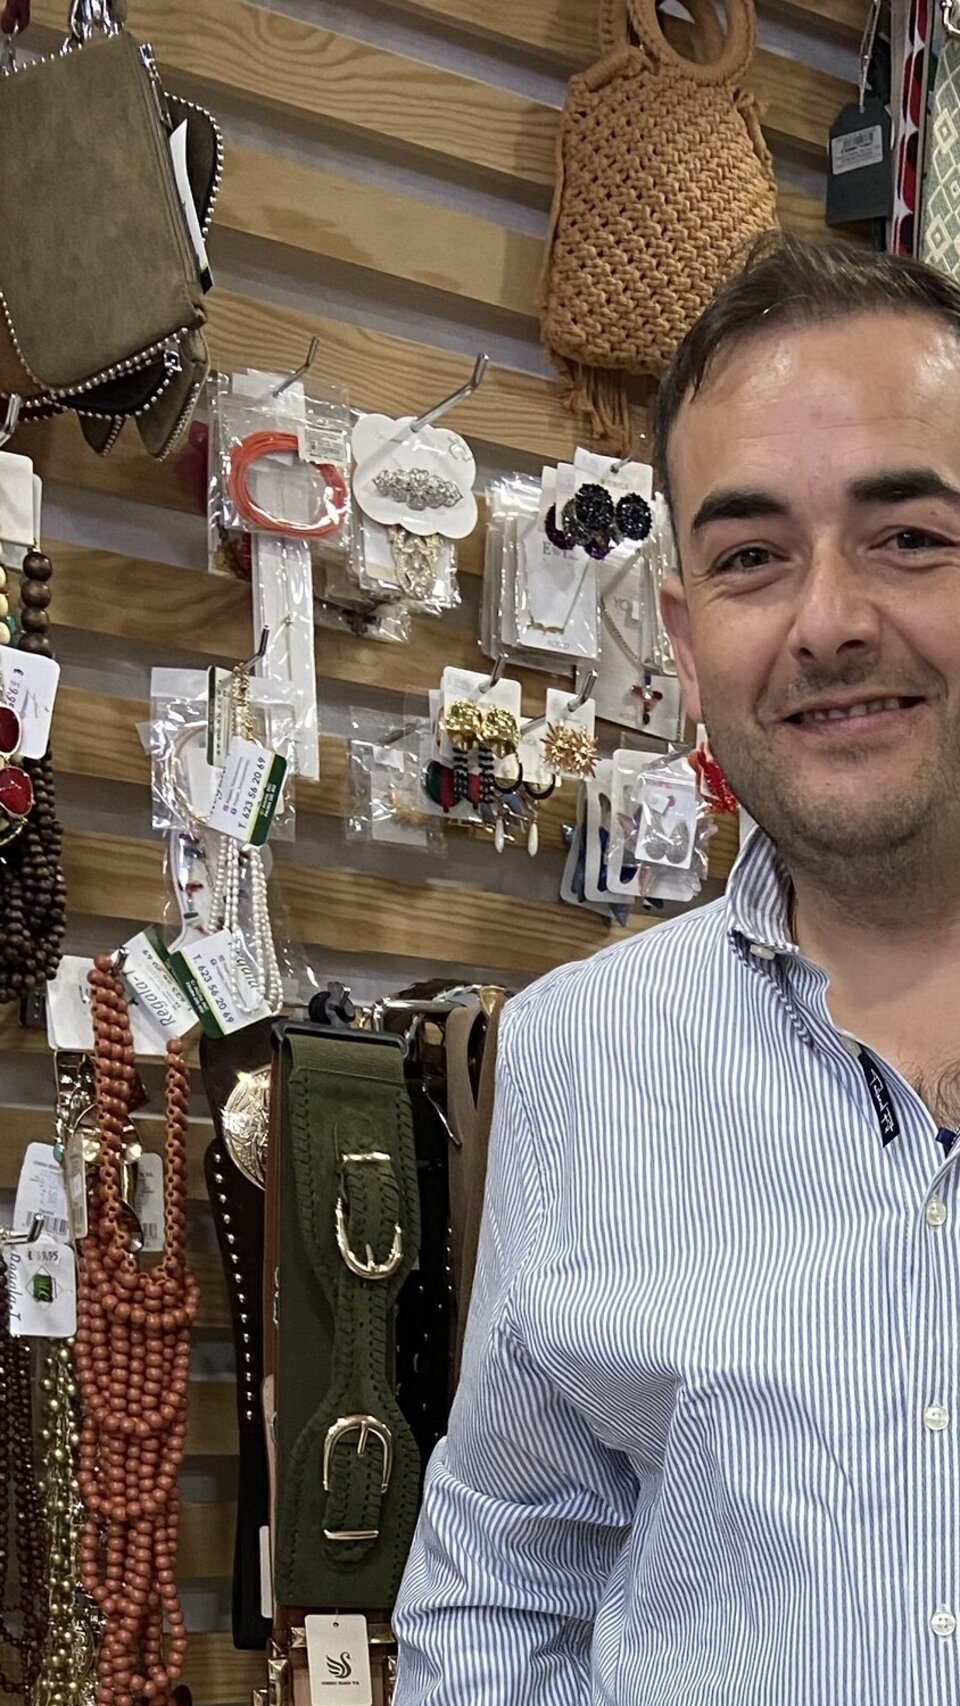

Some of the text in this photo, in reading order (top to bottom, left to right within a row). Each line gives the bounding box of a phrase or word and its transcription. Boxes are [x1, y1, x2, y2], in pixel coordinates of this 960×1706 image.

[257, 757, 266, 770] 69
[252, 772, 262, 785] 20
[248, 787, 258, 799] 56
[241, 801, 254, 819] 623
[199, 965, 213, 983] 623
[208, 982, 220, 995] 56
[216, 996, 227, 1011] 20
[222, 1009, 234, 1023] 69
